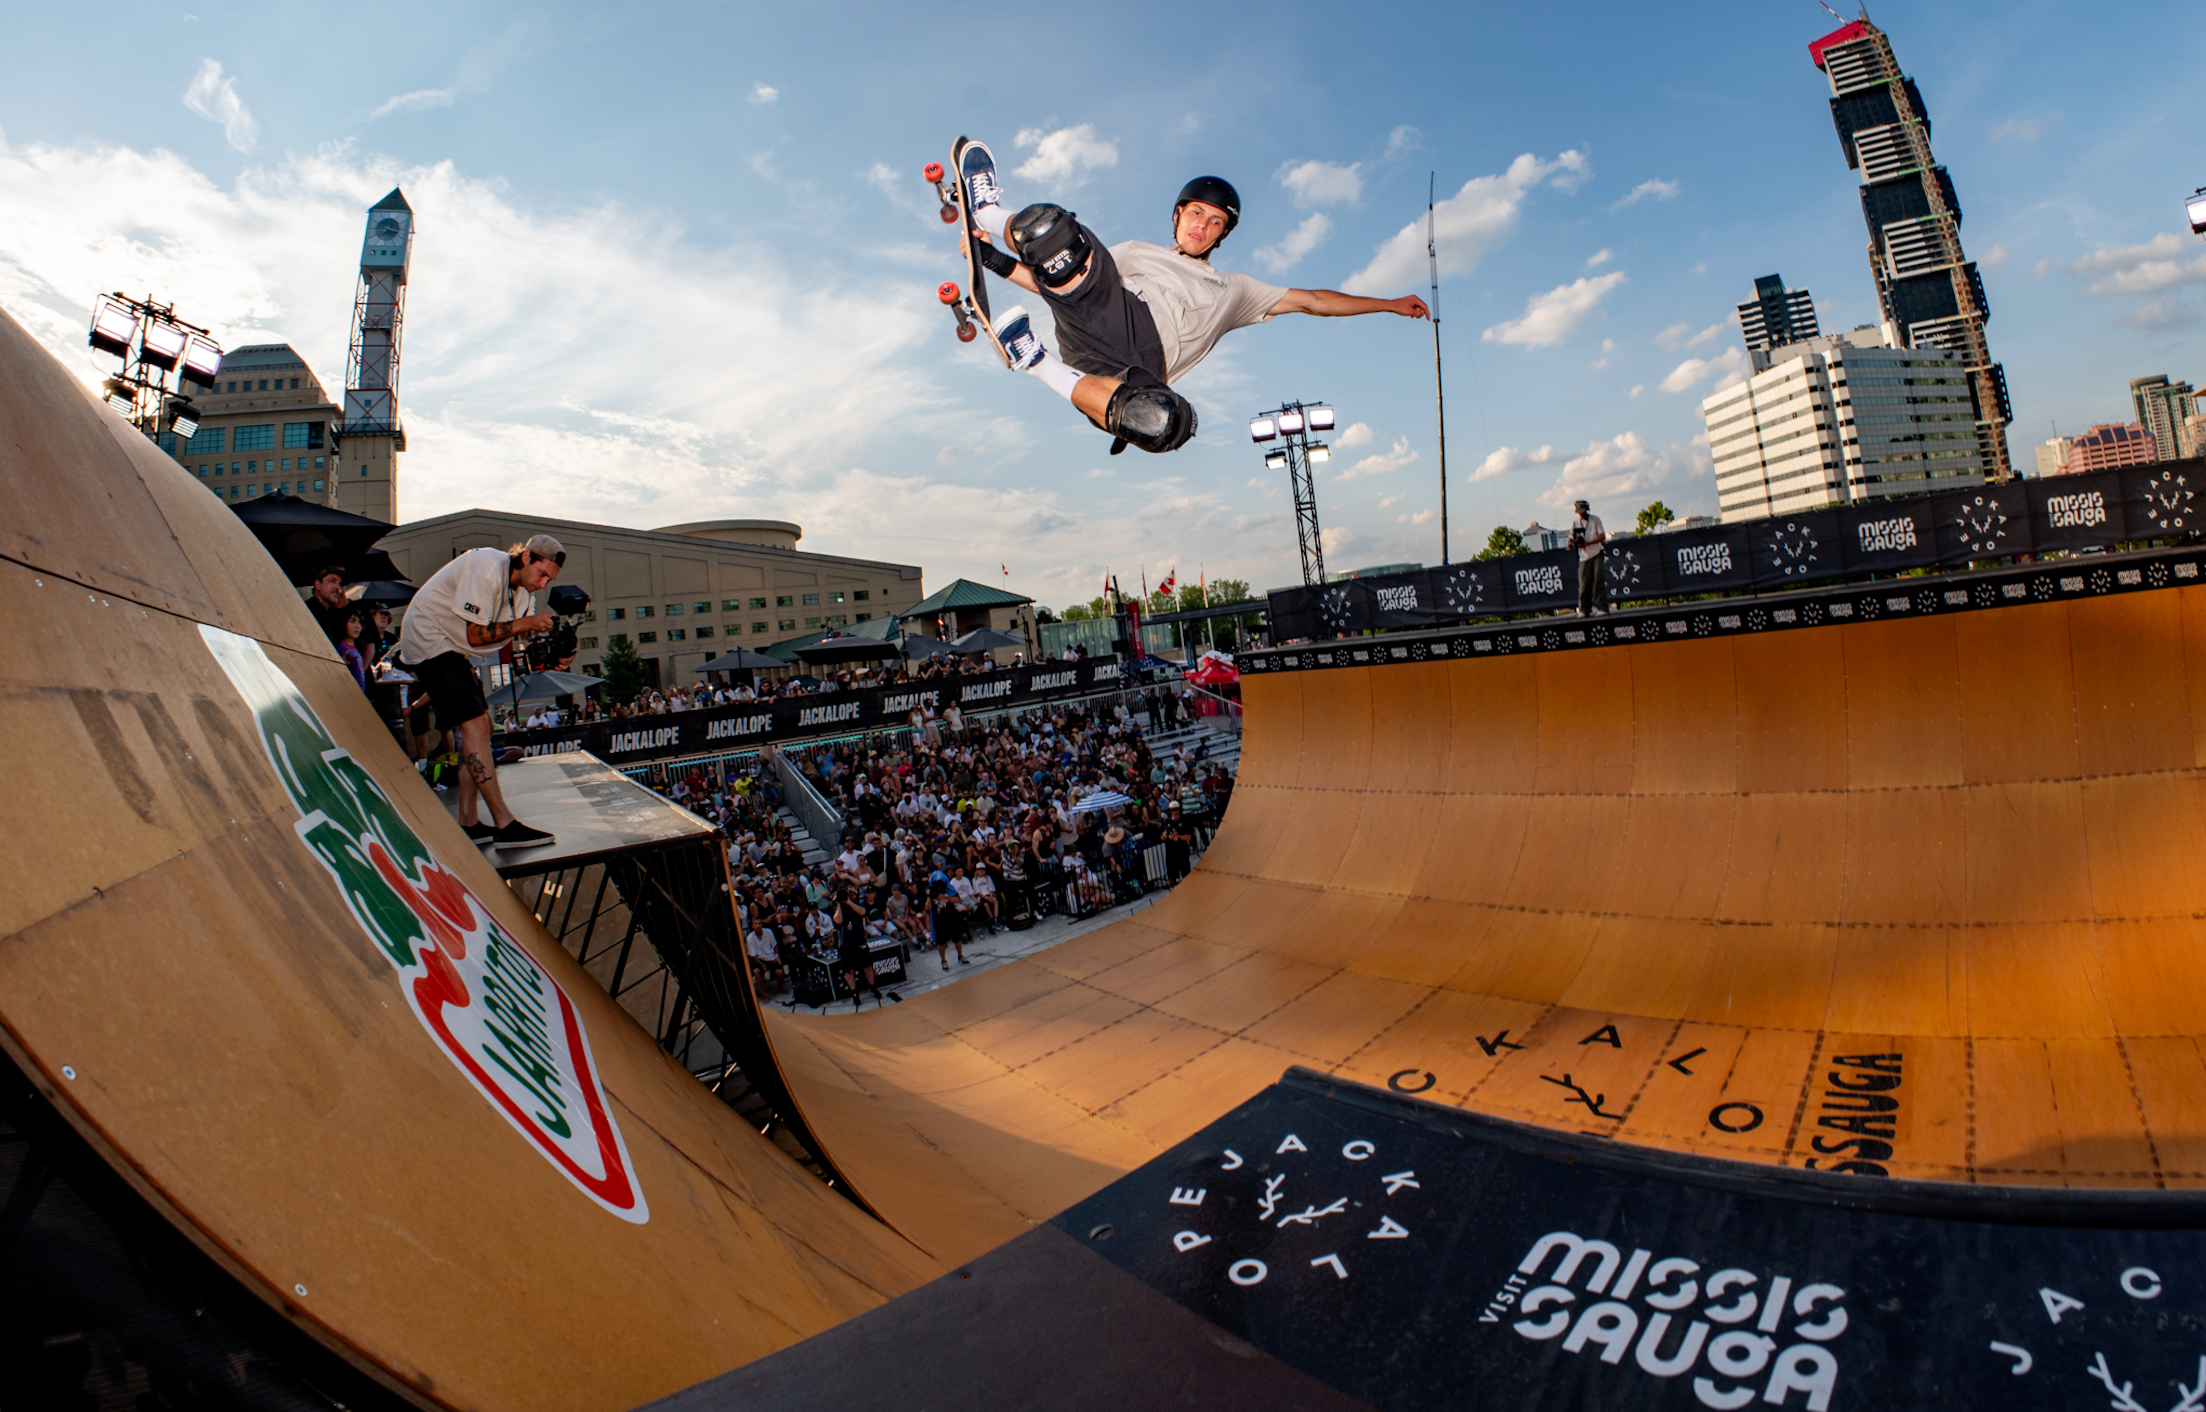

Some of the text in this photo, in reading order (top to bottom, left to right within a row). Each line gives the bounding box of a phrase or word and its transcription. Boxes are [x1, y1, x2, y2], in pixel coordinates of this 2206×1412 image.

[1049, 254, 1072, 274] 187
[2047, 491, 2104, 513] MISSIS
[2144, 471, 2194, 528] JACKALOPE
[1858, 516, 1914, 538] MISSIS
[1956, 496, 2007, 551] JACKALOPE
[1677, 542, 1730, 562] MISSIS
[1515, 565, 1561, 583] MISSIS
[1376, 585, 1416, 600] MISSIS
[464, 602, 480, 615] CREW
[960, 679, 1012, 702] JACKALOPE
[1030, 670, 1077, 691] JACKALOPE
[798, 701, 860, 726] JACKALOPE
[706, 713, 773, 740] JACKALOPE
[523, 739, 582, 758] CKALOPE
[609, 726, 680, 754] JACKALOPE
[482, 921, 572, 1139] JARRITOS
[1169, 1134, 1420, 1286] JACKALOPE
[1517, 1231, 1848, 1341] MISSIS
[1478, 1273, 1528, 1323] VISIT
